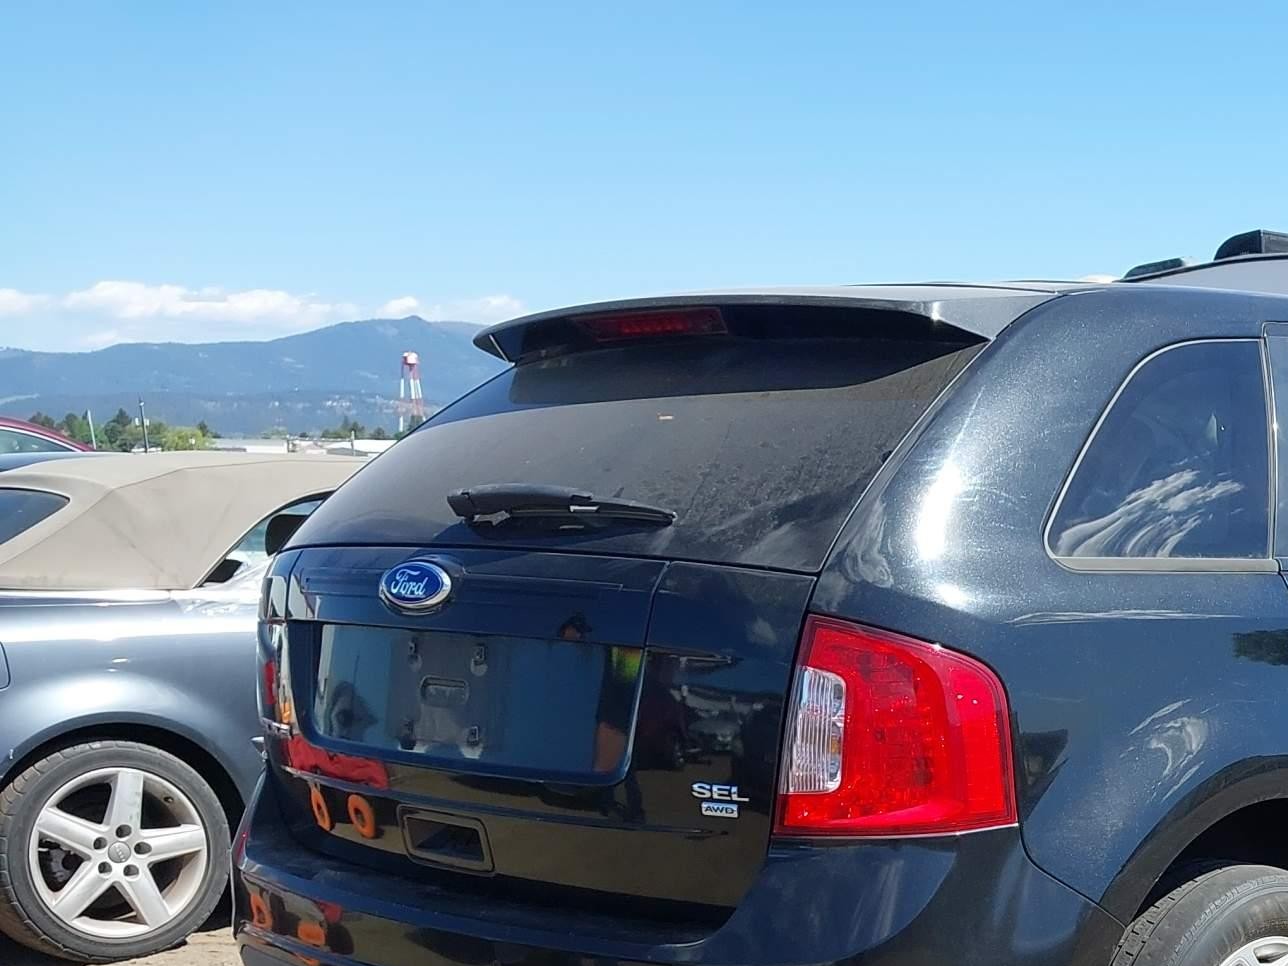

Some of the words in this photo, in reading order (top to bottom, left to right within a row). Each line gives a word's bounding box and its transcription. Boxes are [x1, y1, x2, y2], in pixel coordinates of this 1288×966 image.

[390, 568, 429, 596] Ford
[691, 782, 750, 802] SEL
[704, 805, 735, 815] AWD
